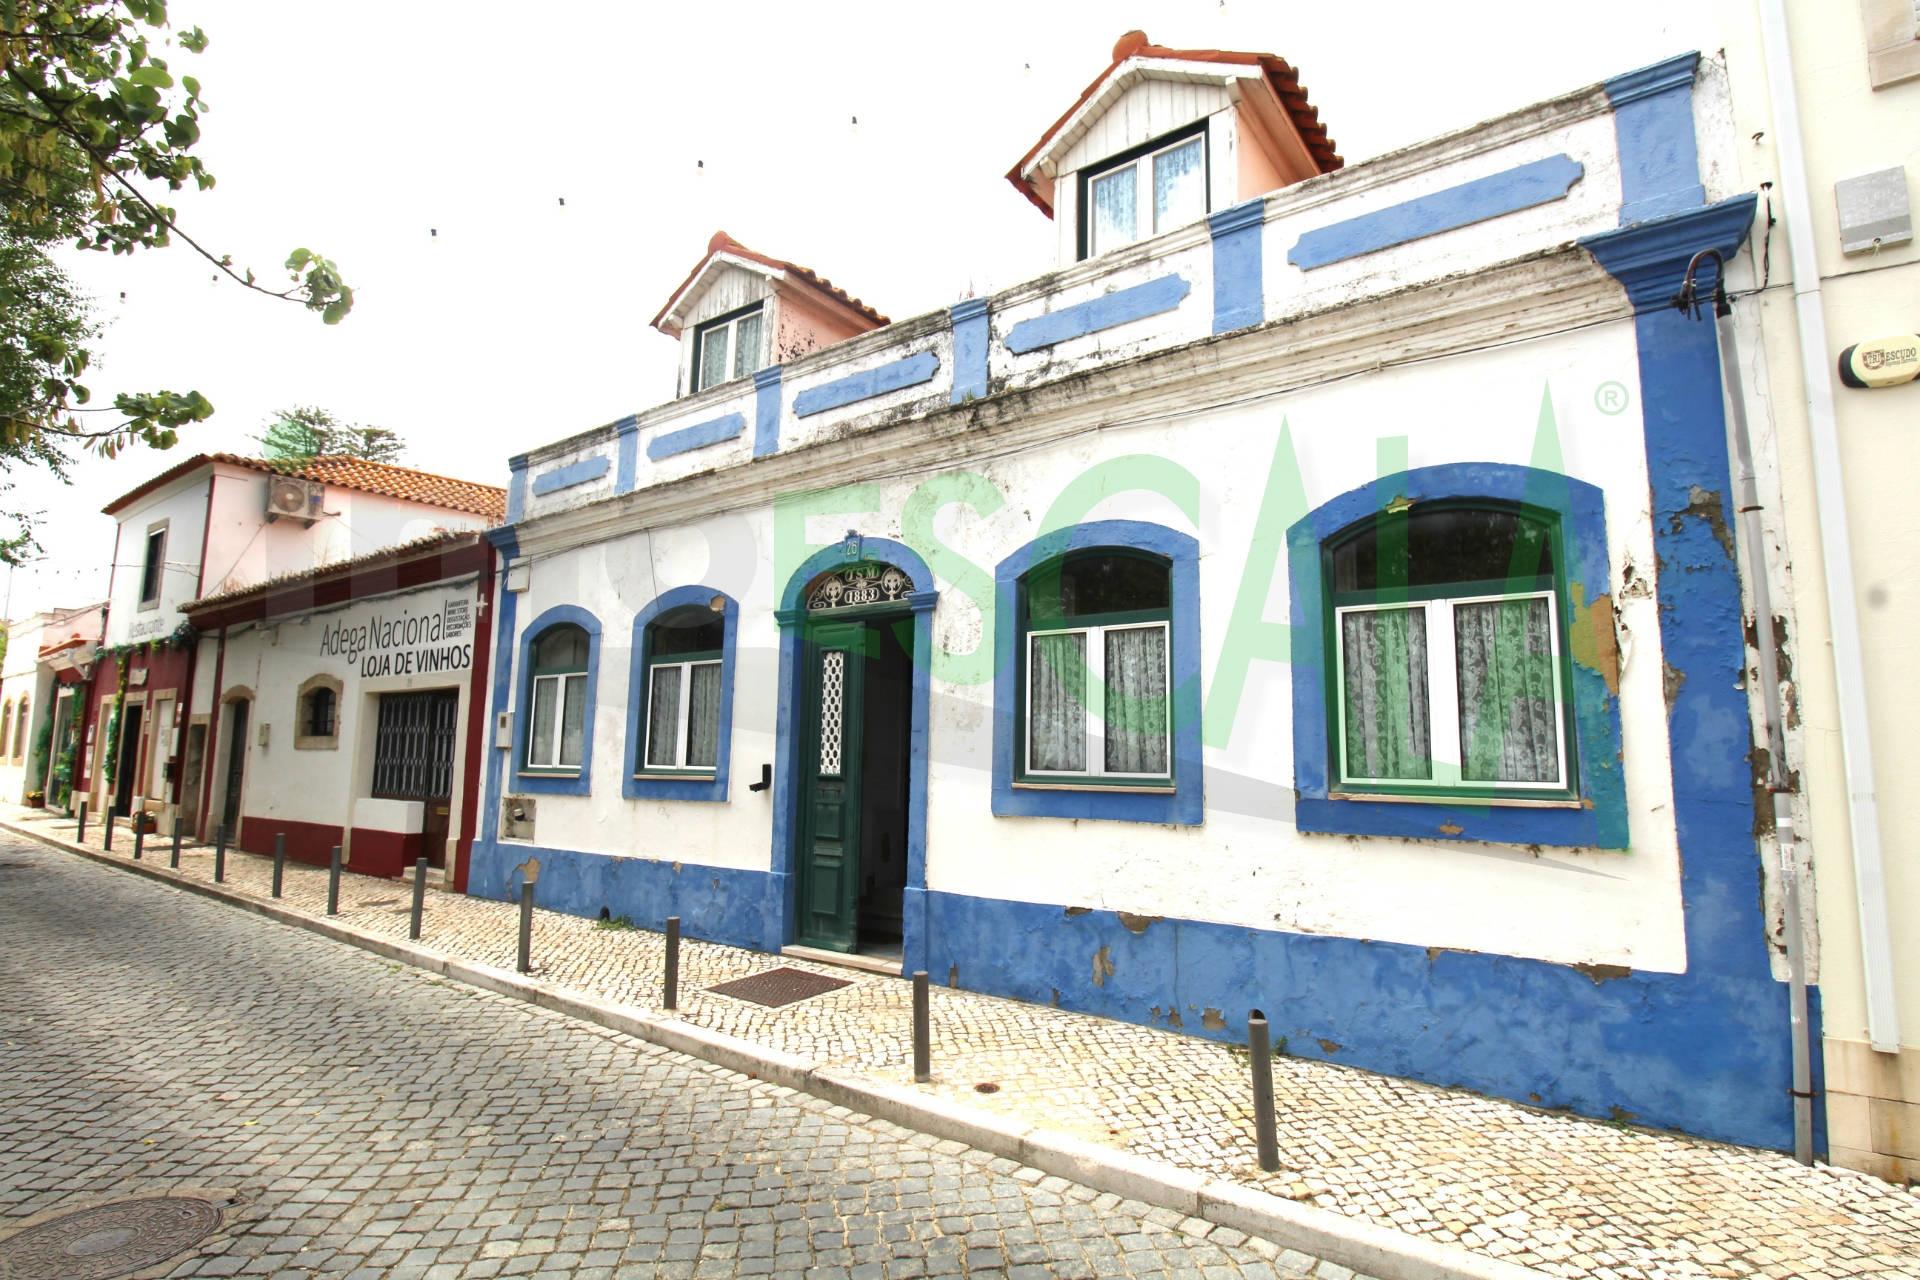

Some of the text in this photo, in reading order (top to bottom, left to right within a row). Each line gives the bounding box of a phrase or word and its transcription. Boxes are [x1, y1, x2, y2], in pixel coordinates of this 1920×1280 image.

[1886, 347, 1917, 361] ESCUDO
[849, 589, 875, 603] 1883
[320, 600, 447, 664] Adega Nacional
[361, 644, 472, 678] LOJA DE VINHOS
